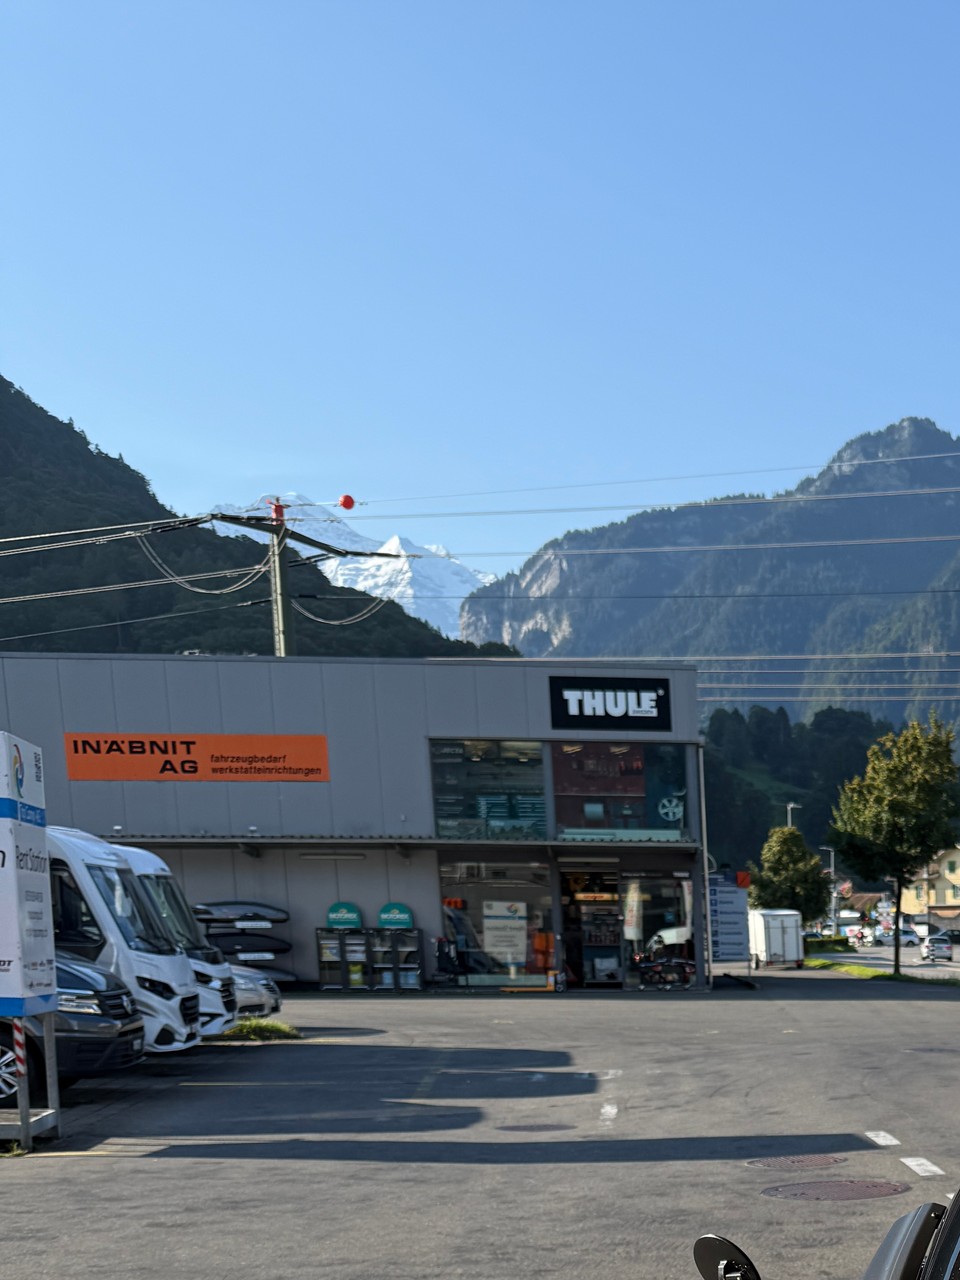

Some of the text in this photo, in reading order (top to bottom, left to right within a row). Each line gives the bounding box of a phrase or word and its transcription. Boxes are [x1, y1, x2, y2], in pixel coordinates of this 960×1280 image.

[73, 740, 197, 755] INÄBNIT
[210, 754, 286, 765] fahrzeugbedarf
[159, 760, 198, 774] AG
[211, 766, 321, 777] werkstatteinrichtungen
